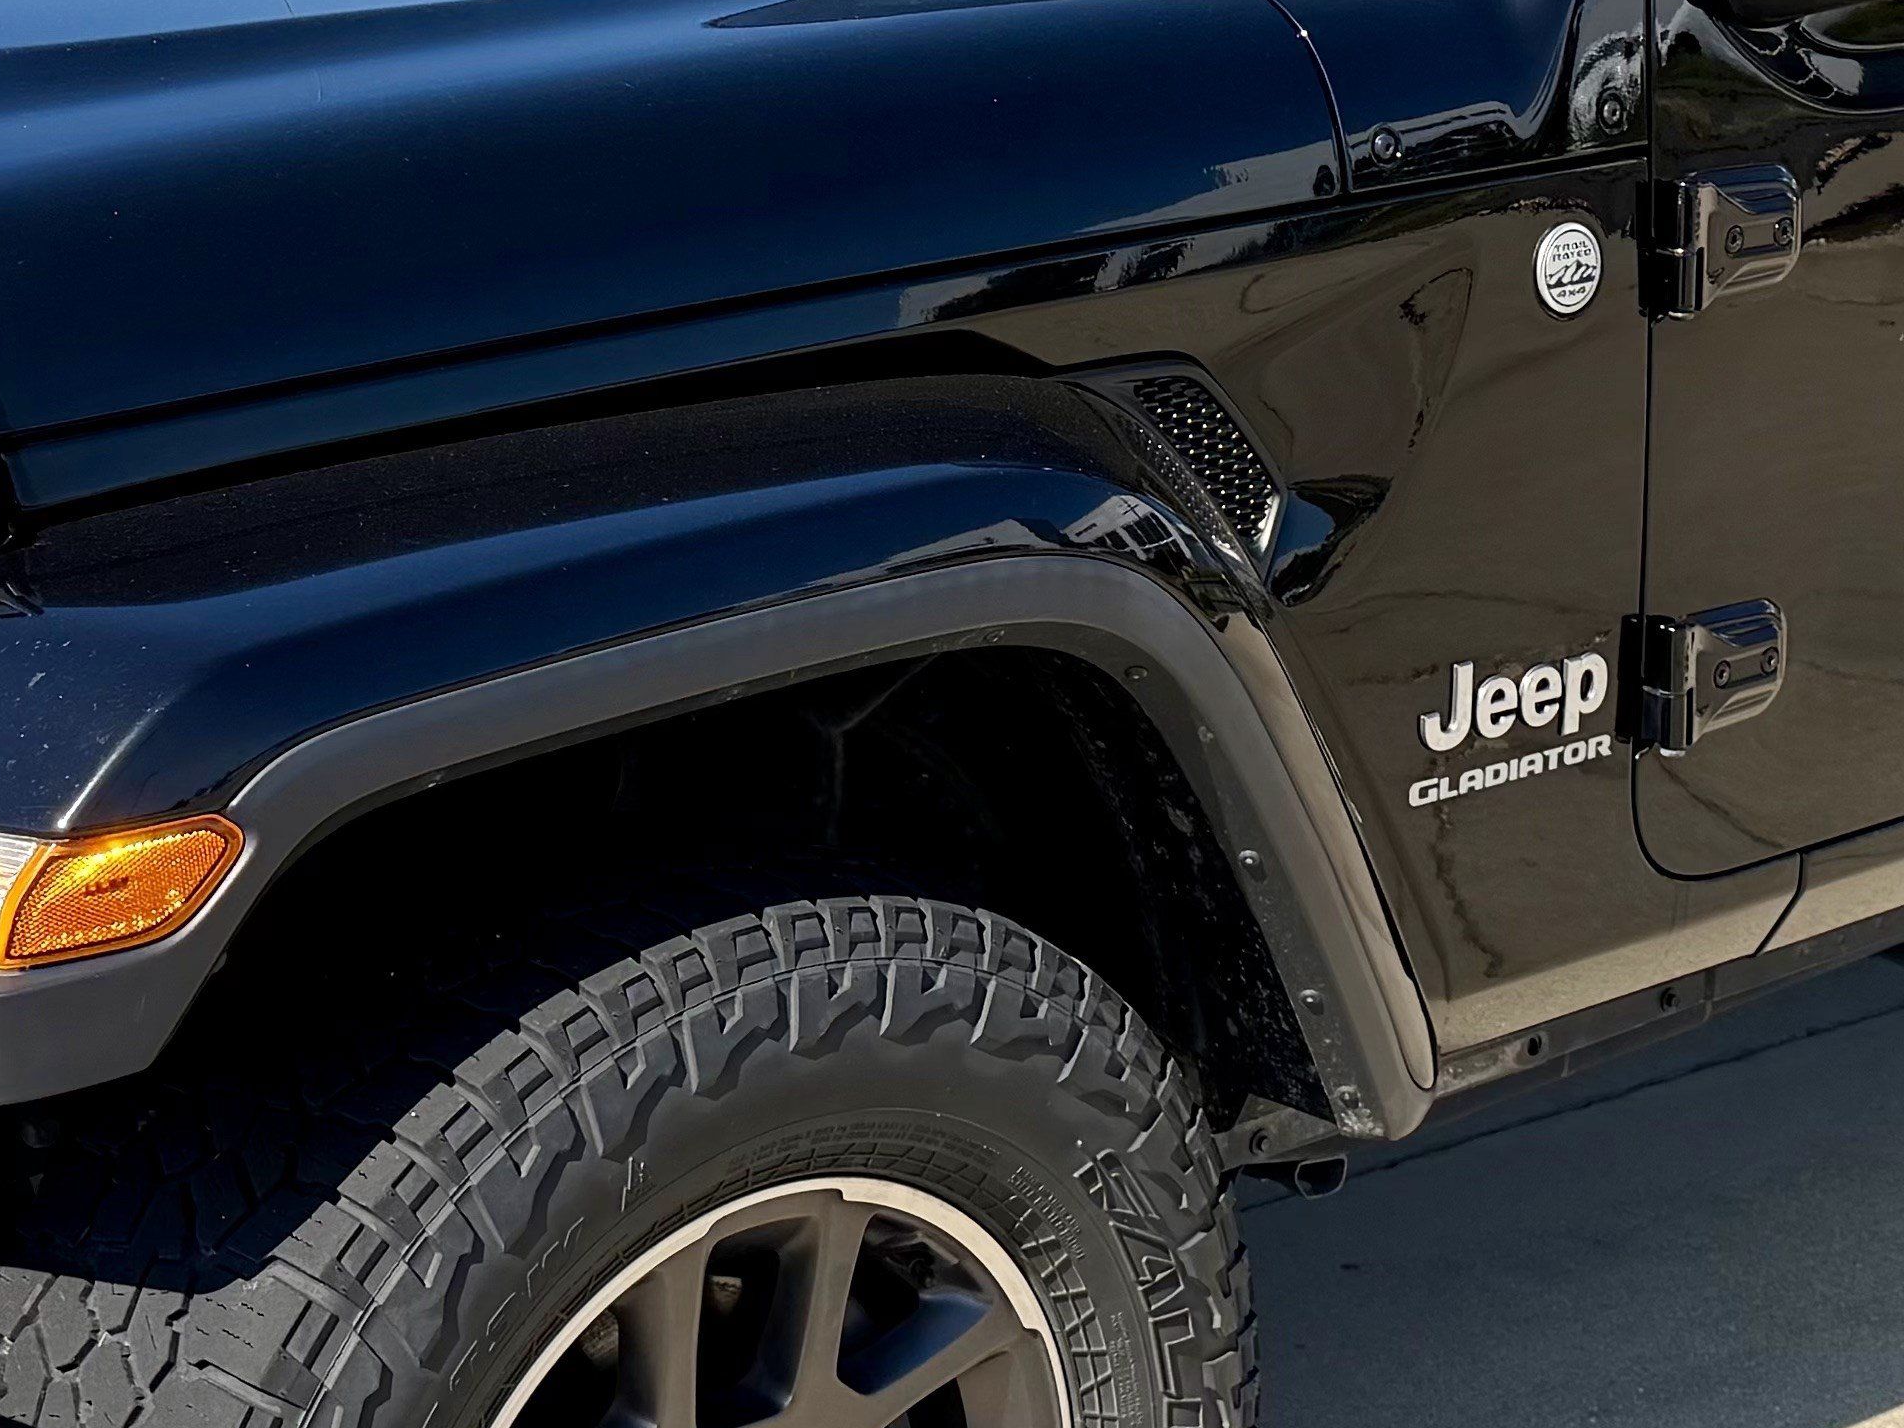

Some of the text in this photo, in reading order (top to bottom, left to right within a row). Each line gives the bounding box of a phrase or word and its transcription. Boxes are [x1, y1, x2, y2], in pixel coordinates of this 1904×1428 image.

[1552, 248, 1591, 262] RATED
[1553, 240, 1588, 252] TRAIL
[1419, 652, 1608, 752] Jeep
[1408, 734, 1612, 807] GLADIATOR
